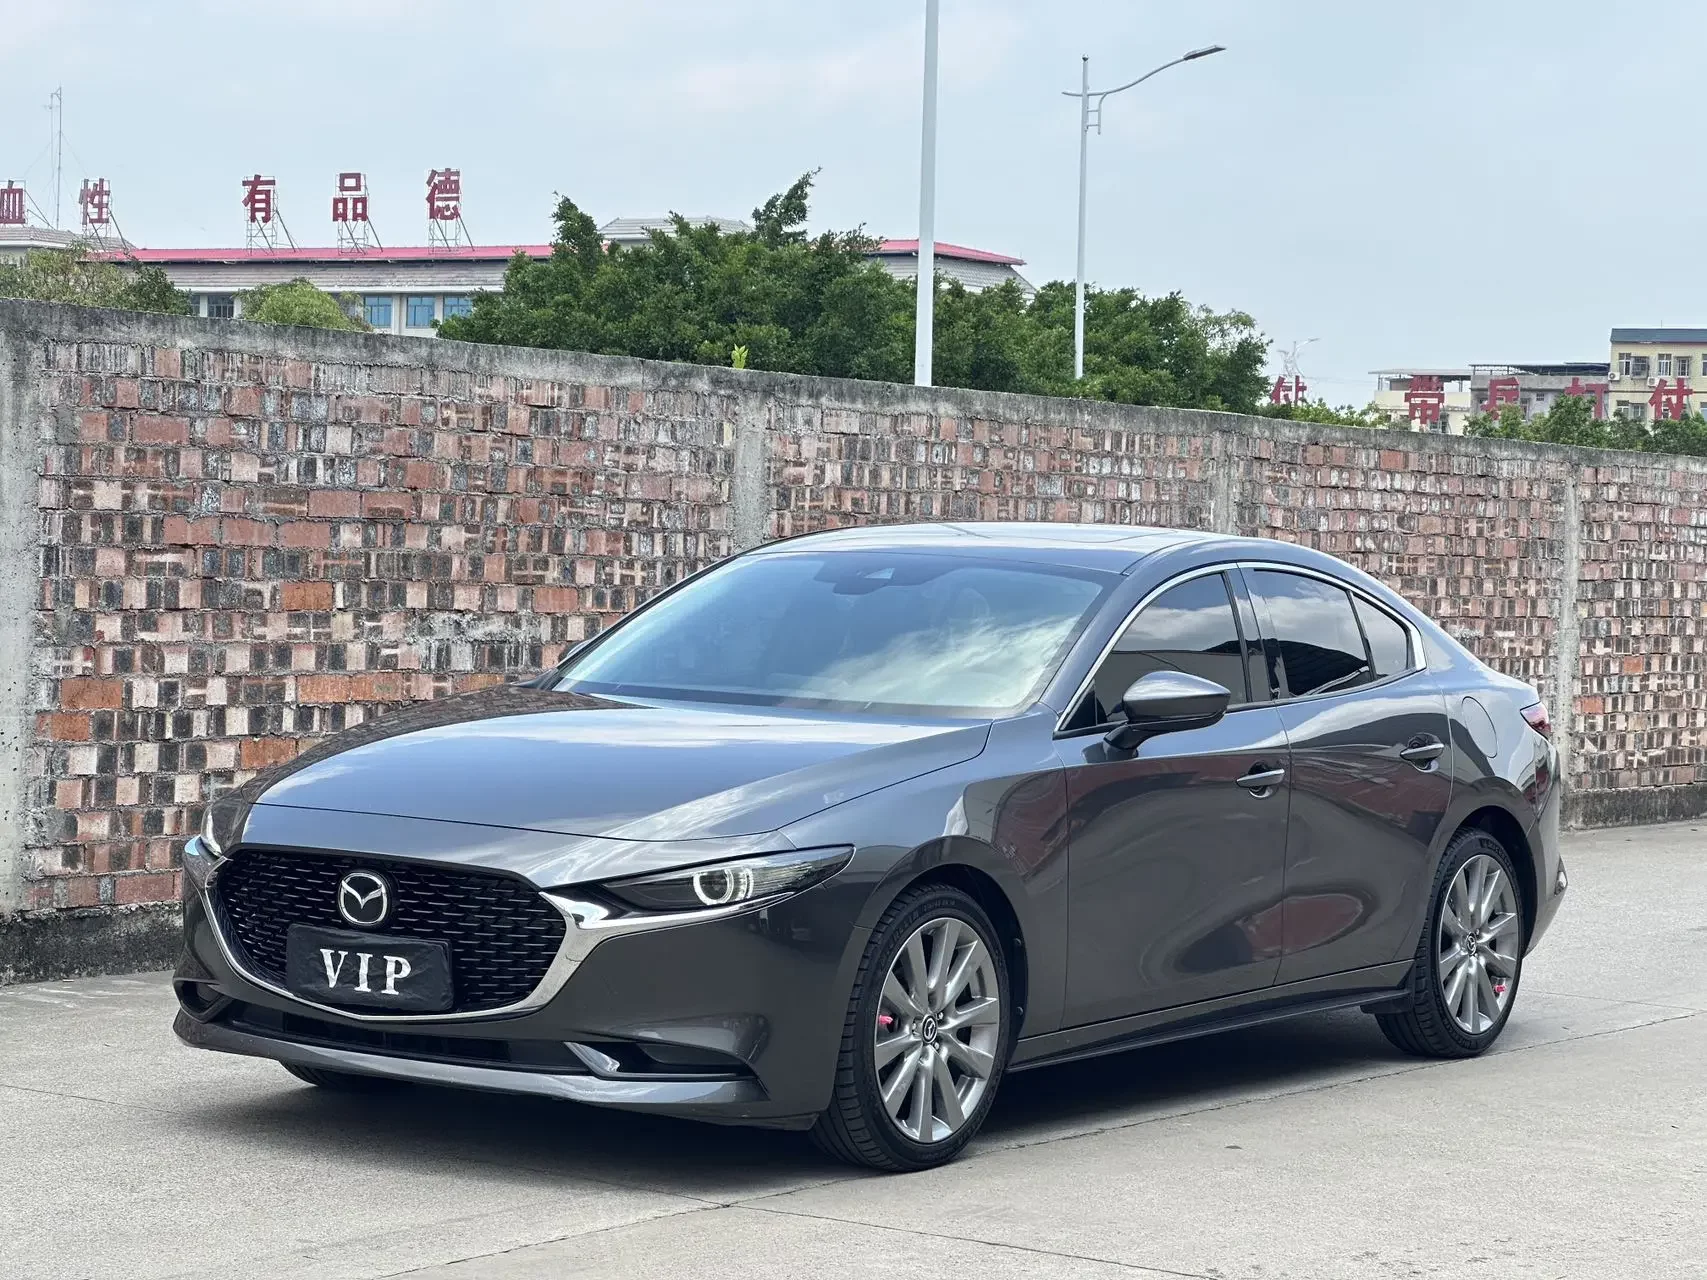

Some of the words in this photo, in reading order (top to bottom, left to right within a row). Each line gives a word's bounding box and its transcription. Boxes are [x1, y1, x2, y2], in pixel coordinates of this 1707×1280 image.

[0, 178, 111, 225] 血性
[242, 168, 462, 223] 有品德
[320, 948, 412, 995] VIP
